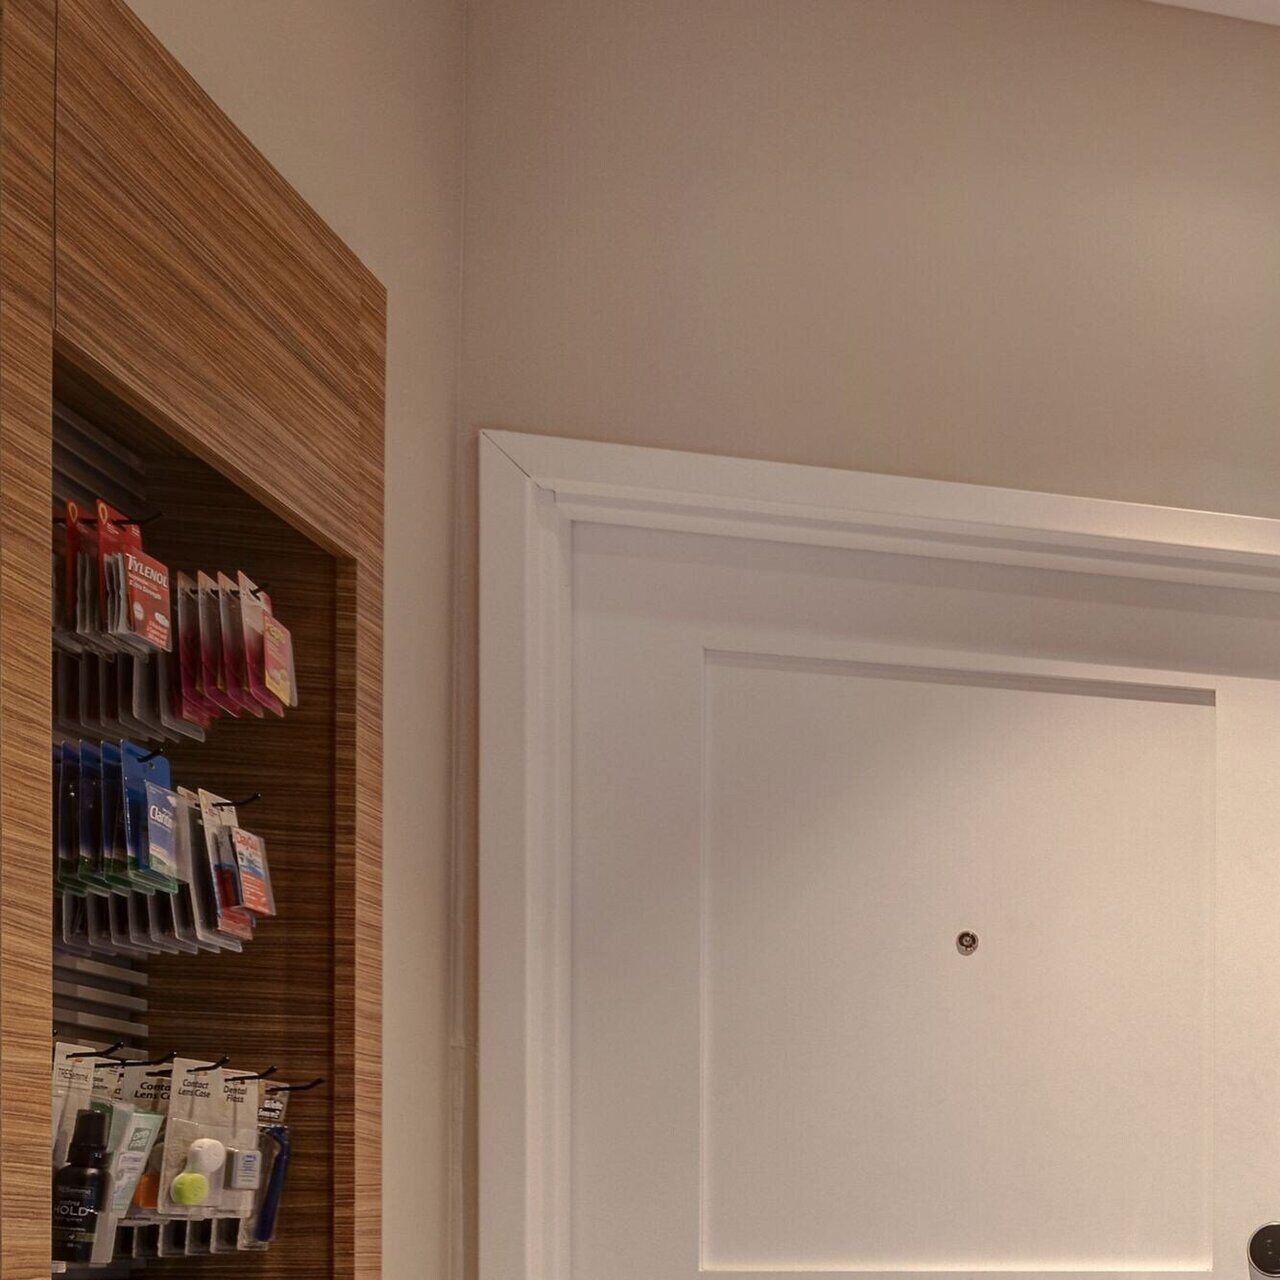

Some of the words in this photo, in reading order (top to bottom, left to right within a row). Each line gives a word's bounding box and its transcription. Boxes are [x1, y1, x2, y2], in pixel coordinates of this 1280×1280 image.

[182, 1078, 209, 1089] Contact
[134, 1090, 159, 1099] Lens
[178, 1088, 193, 1097] Lens
[195, 1089, 211, 1098] Case
[223, 1085, 248, 1095] Dental
